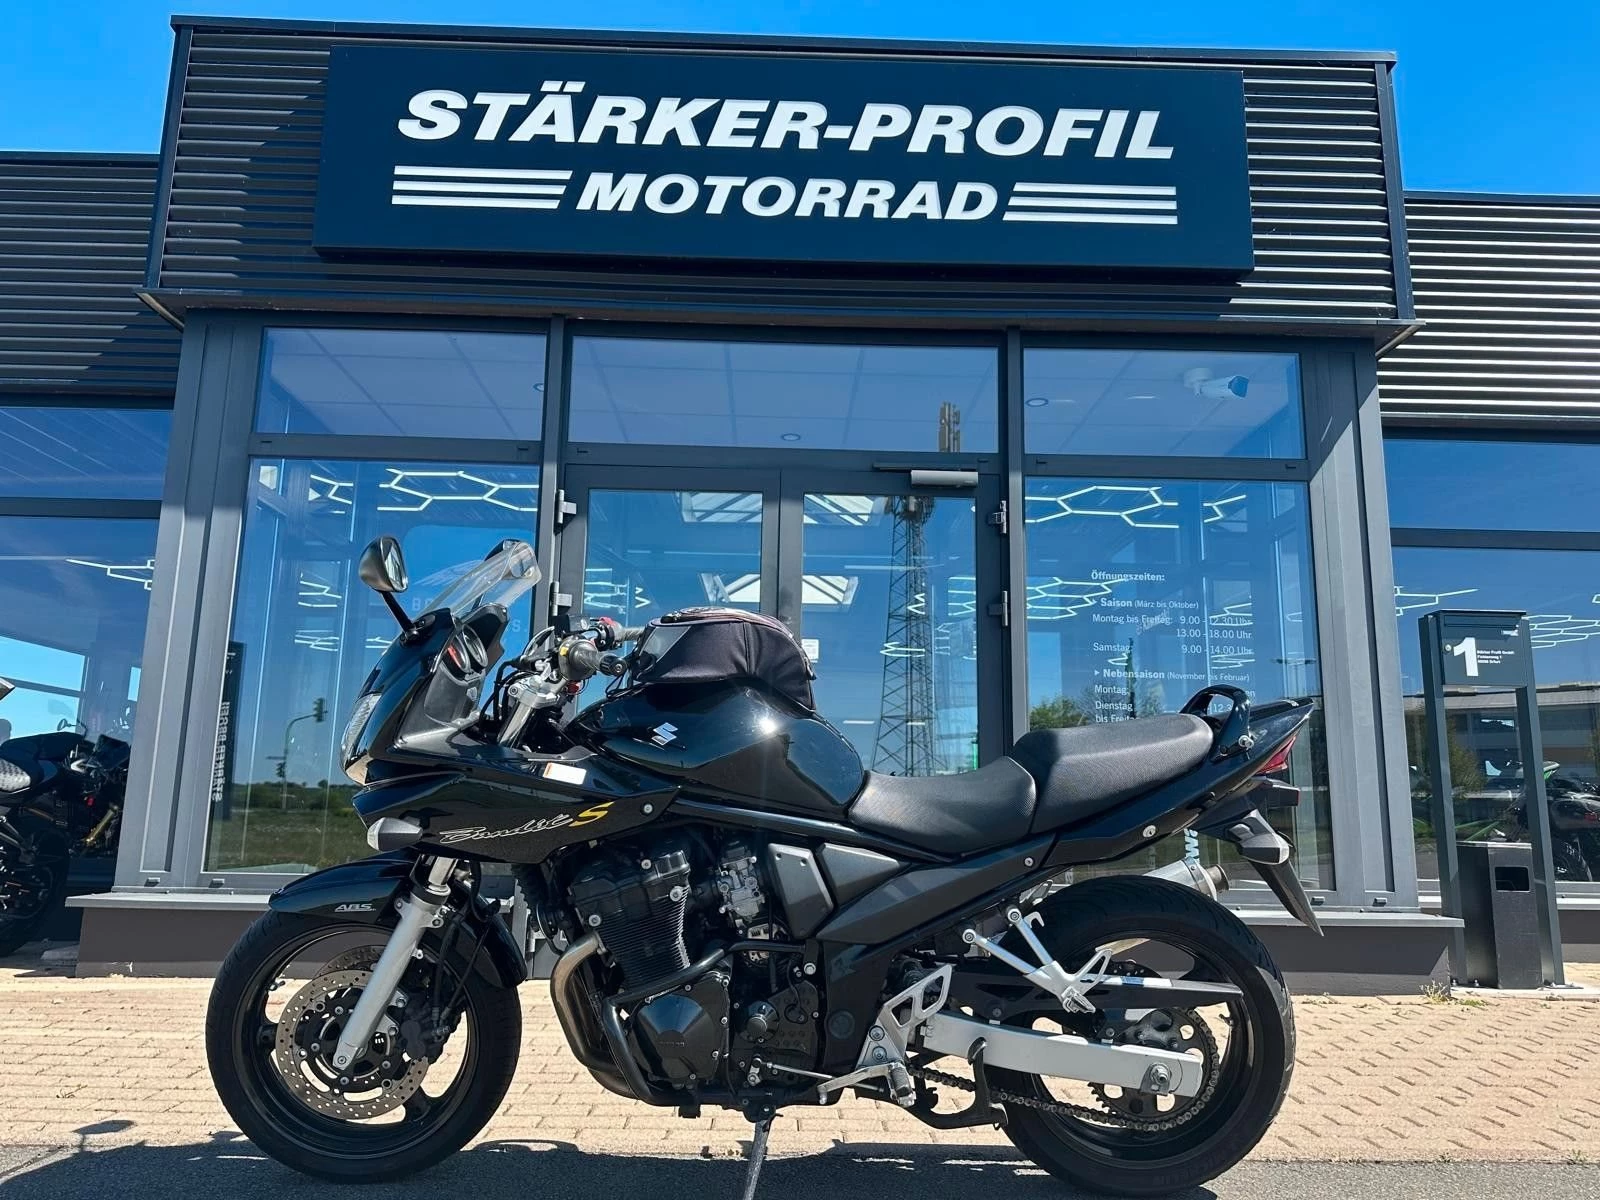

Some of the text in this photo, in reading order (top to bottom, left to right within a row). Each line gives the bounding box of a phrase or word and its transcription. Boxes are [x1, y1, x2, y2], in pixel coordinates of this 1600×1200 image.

[398, 81, 1174, 160] STÄRKER-PROFIL
[576, 172, 998, 221] MOTORRAD
[1091, 569, 1165, 582] Öffnungszeiten:
[1101, 598, 1133, 607] Saison
[1134, 600, 1155, 609] (März
[1156, 600, 1167, 608] bis
[1092, 614, 1125, 625] Montag
[1126, 614, 1139, 623] bis
[1179, 615, 1201, 625] 9.00
[1176, 628, 1201, 638] 13.00
[1209, 629, 1235, 639] 18.00
[1236, 630, 1252, 639] Uhr
[1181, 644, 1202, 654] 9.00
[1210, 645, 1235, 654] 14.00
[1453, 637, 1479, 676] 1
[1103, 668, 1165, 679] Nebensaison
[1095, 700, 1133, 712] Dienstag
[568, 801, 615, 828] S
[334, 903, 373, 913] ABS
